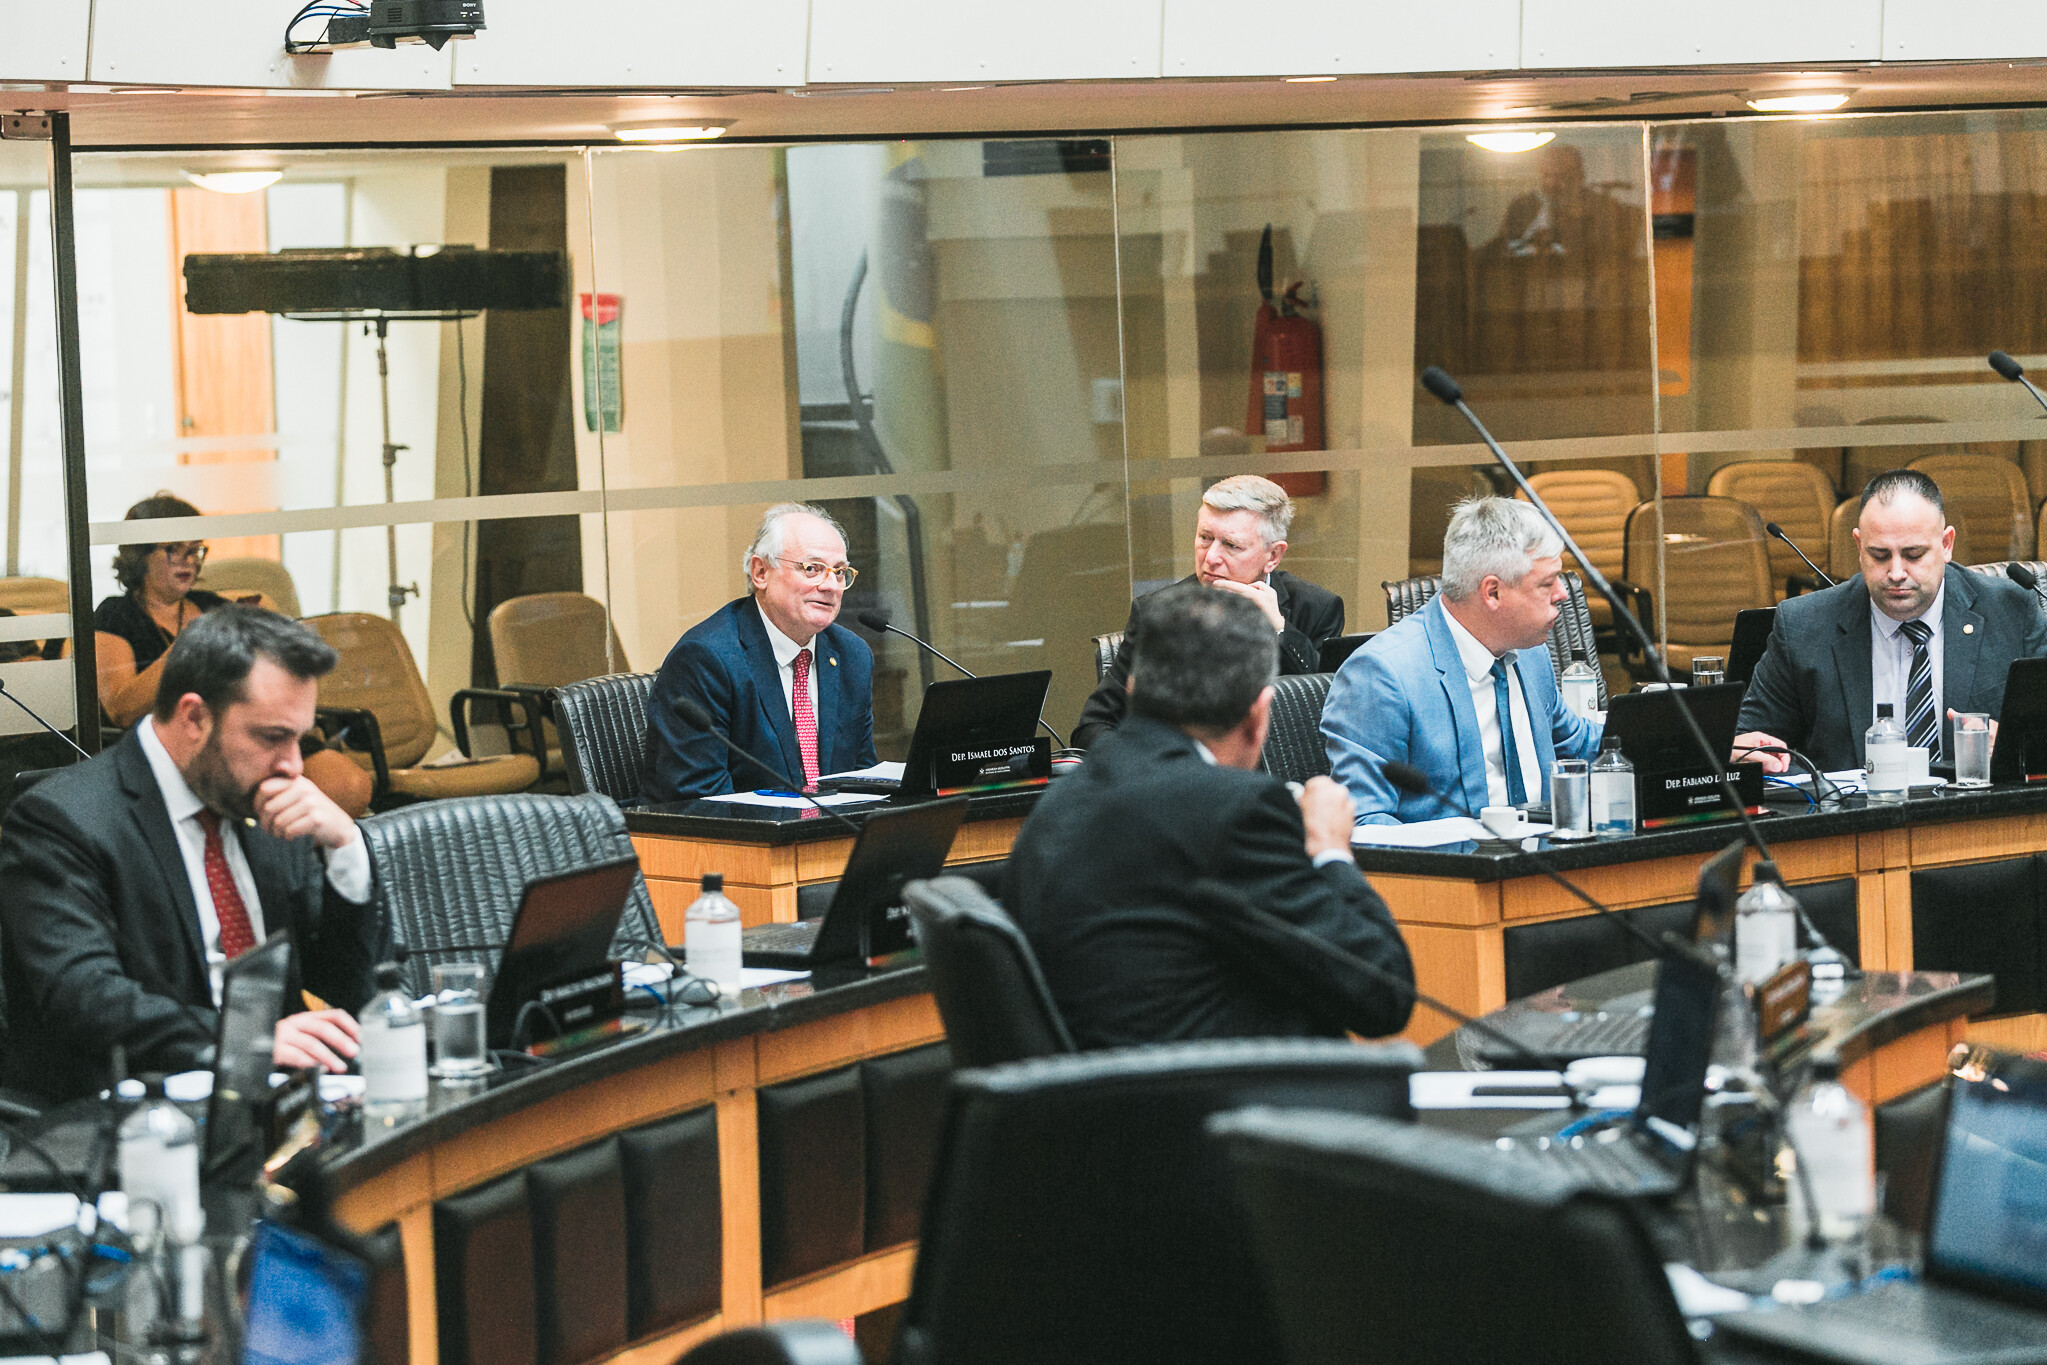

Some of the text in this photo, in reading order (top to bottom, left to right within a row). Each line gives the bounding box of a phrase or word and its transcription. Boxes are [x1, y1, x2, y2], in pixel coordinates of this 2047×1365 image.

[951, 745, 1035, 762] DEP. ISMAEL DOS SANTOS
[1665, 779, 1681, 789] DEP.
[1682, 775, 1714, 787] FABIANO
[1726, 771, 1741, 782] LUZ
